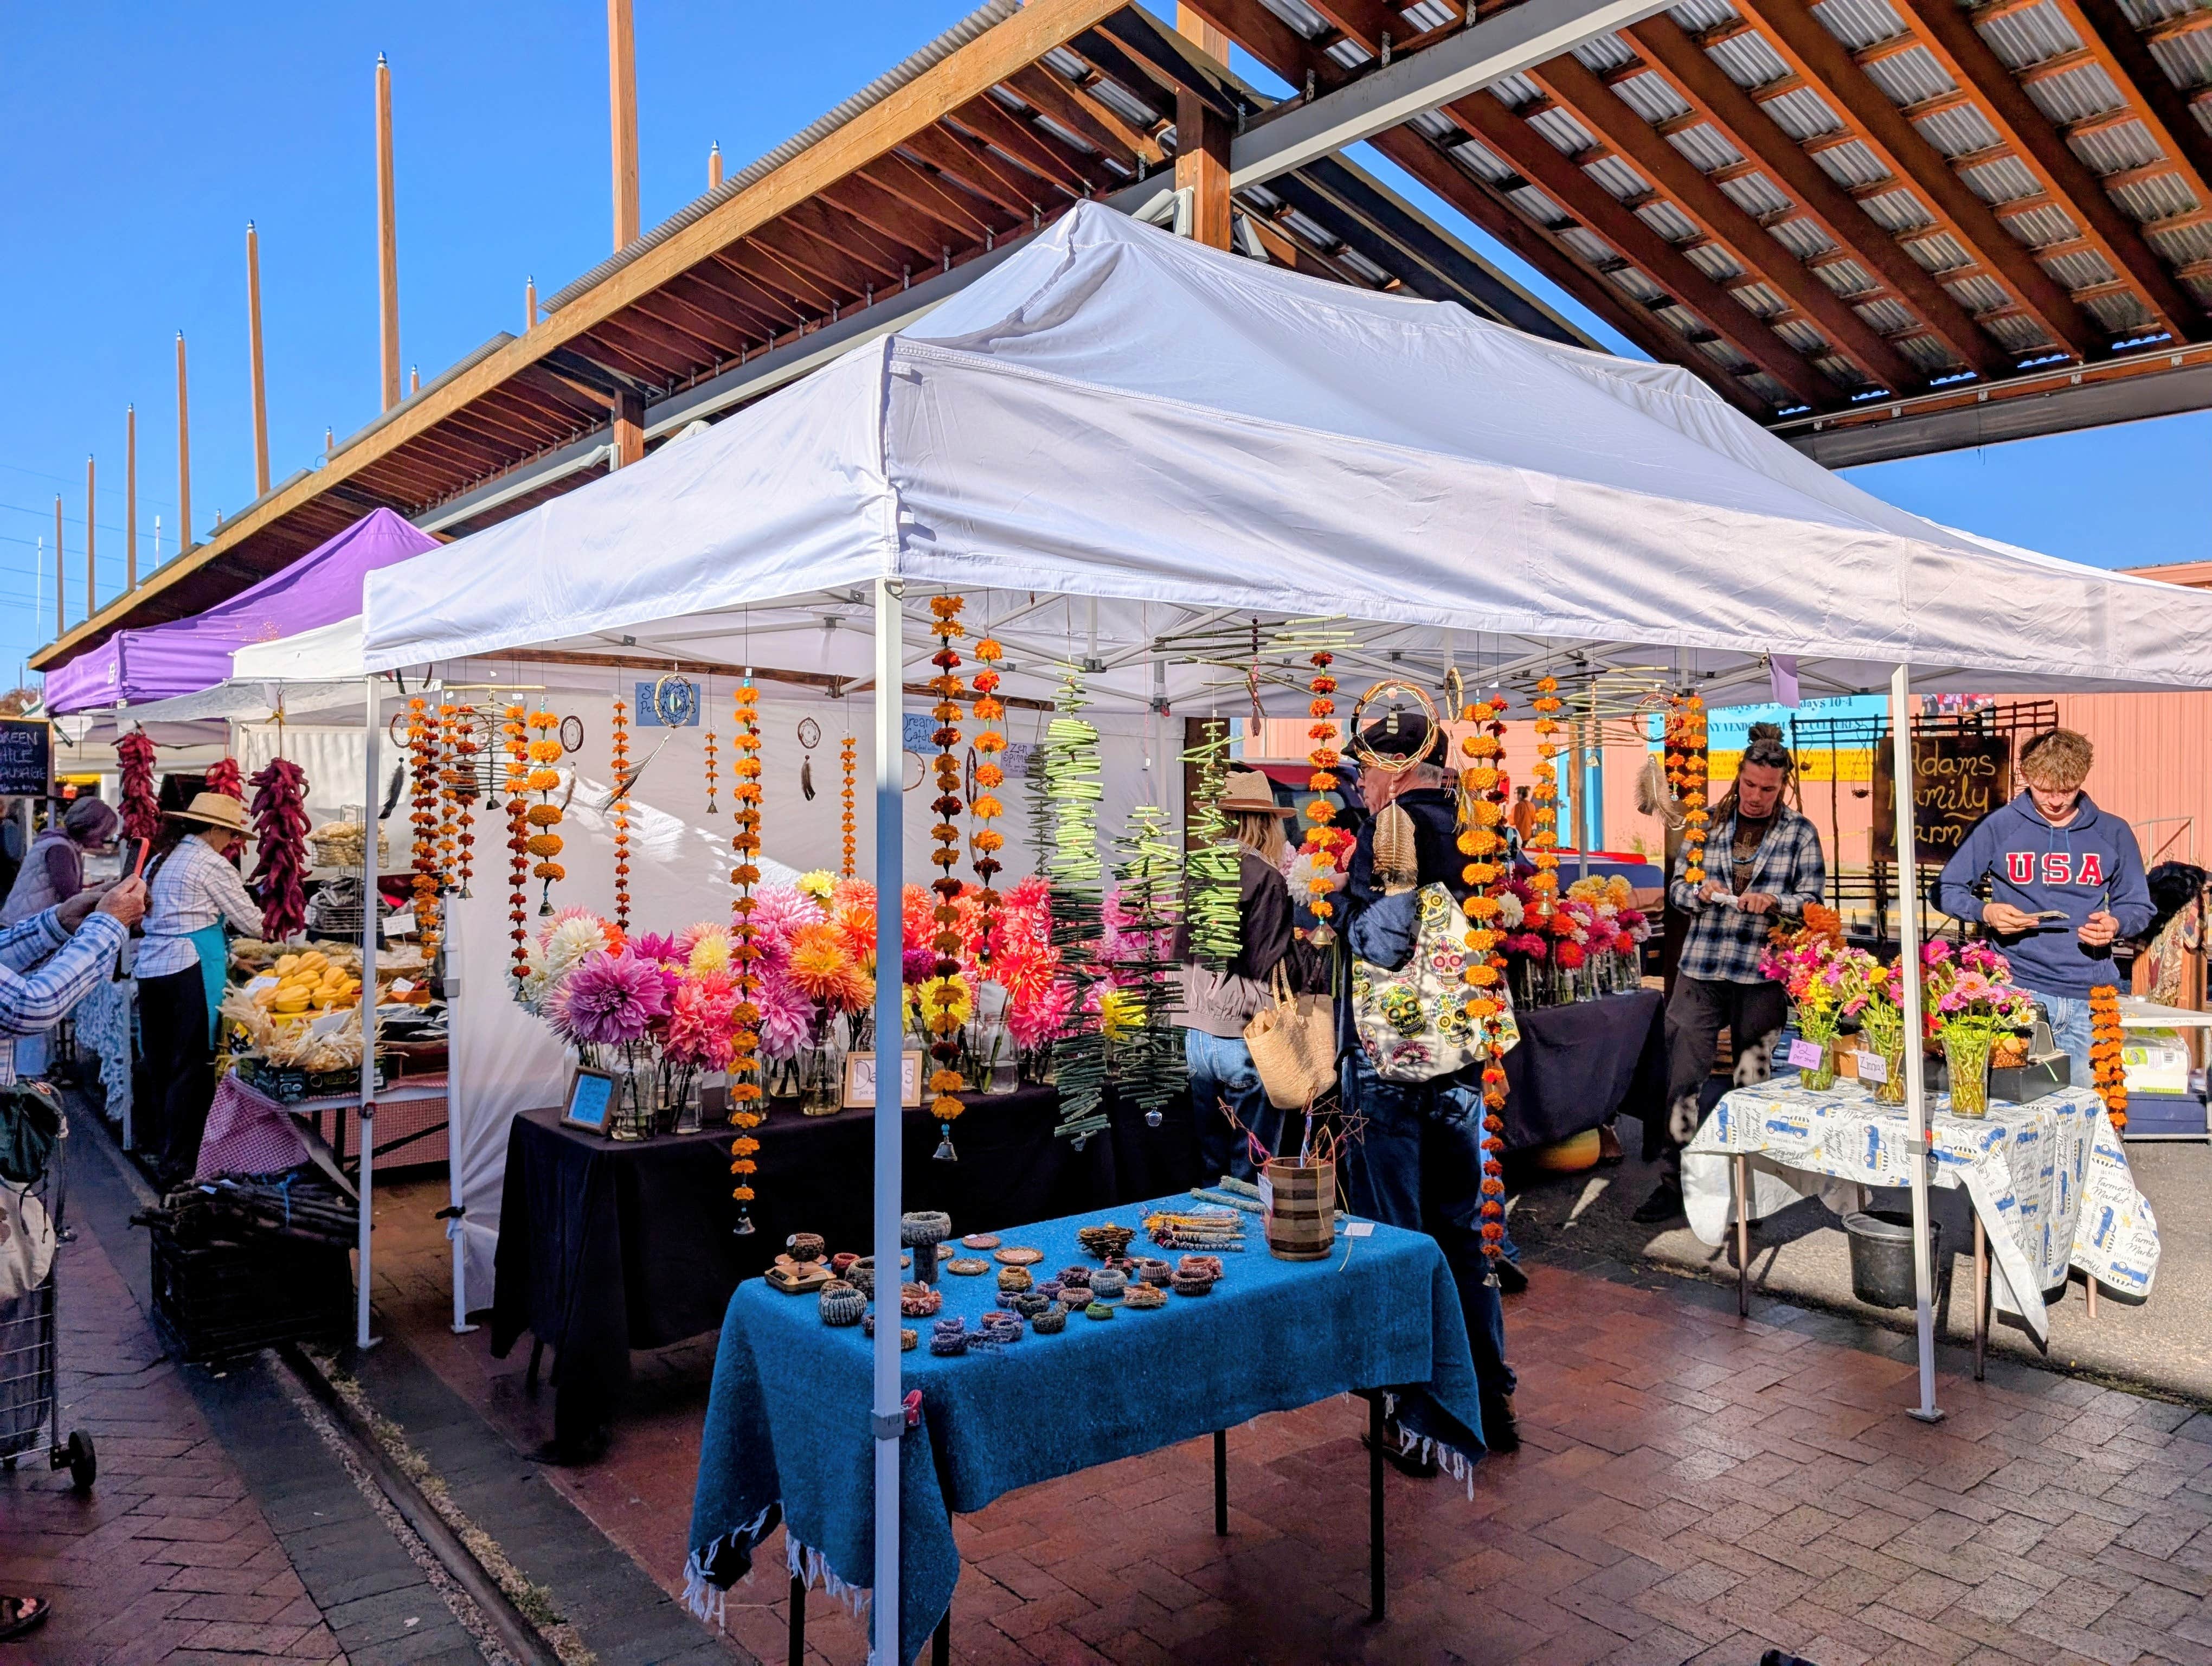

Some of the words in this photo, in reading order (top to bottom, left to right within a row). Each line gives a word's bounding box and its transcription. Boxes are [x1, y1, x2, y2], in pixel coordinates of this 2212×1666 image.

[904, 728, 930, 742] Catch
[1010, 744, 1028, 755] Zen
[2006, 852, 2104, 886] USA
[1796, 1042, 1812, 1056] $2
[1860, 1056, 1885, 1075] Zinnias
[1742, 1106, 1752, 1139] Farmer's
[1752, 1108, 1761, 1143] Market
[1822, 1126, 1836, 1158] Market
[1835, 1130, 1846, 1162] Farmer's
[2055, 1134, 2065, 1167] Market
[2092, 1186, 2130, 1204] Market
[2097, 1177, 2132, 1194] Farmer's
[2133, 1233, 2155, 1246] Farme
[2125, 1242, 2158, 1259] Market
[2070, 1253, 2101, 1274] Market
